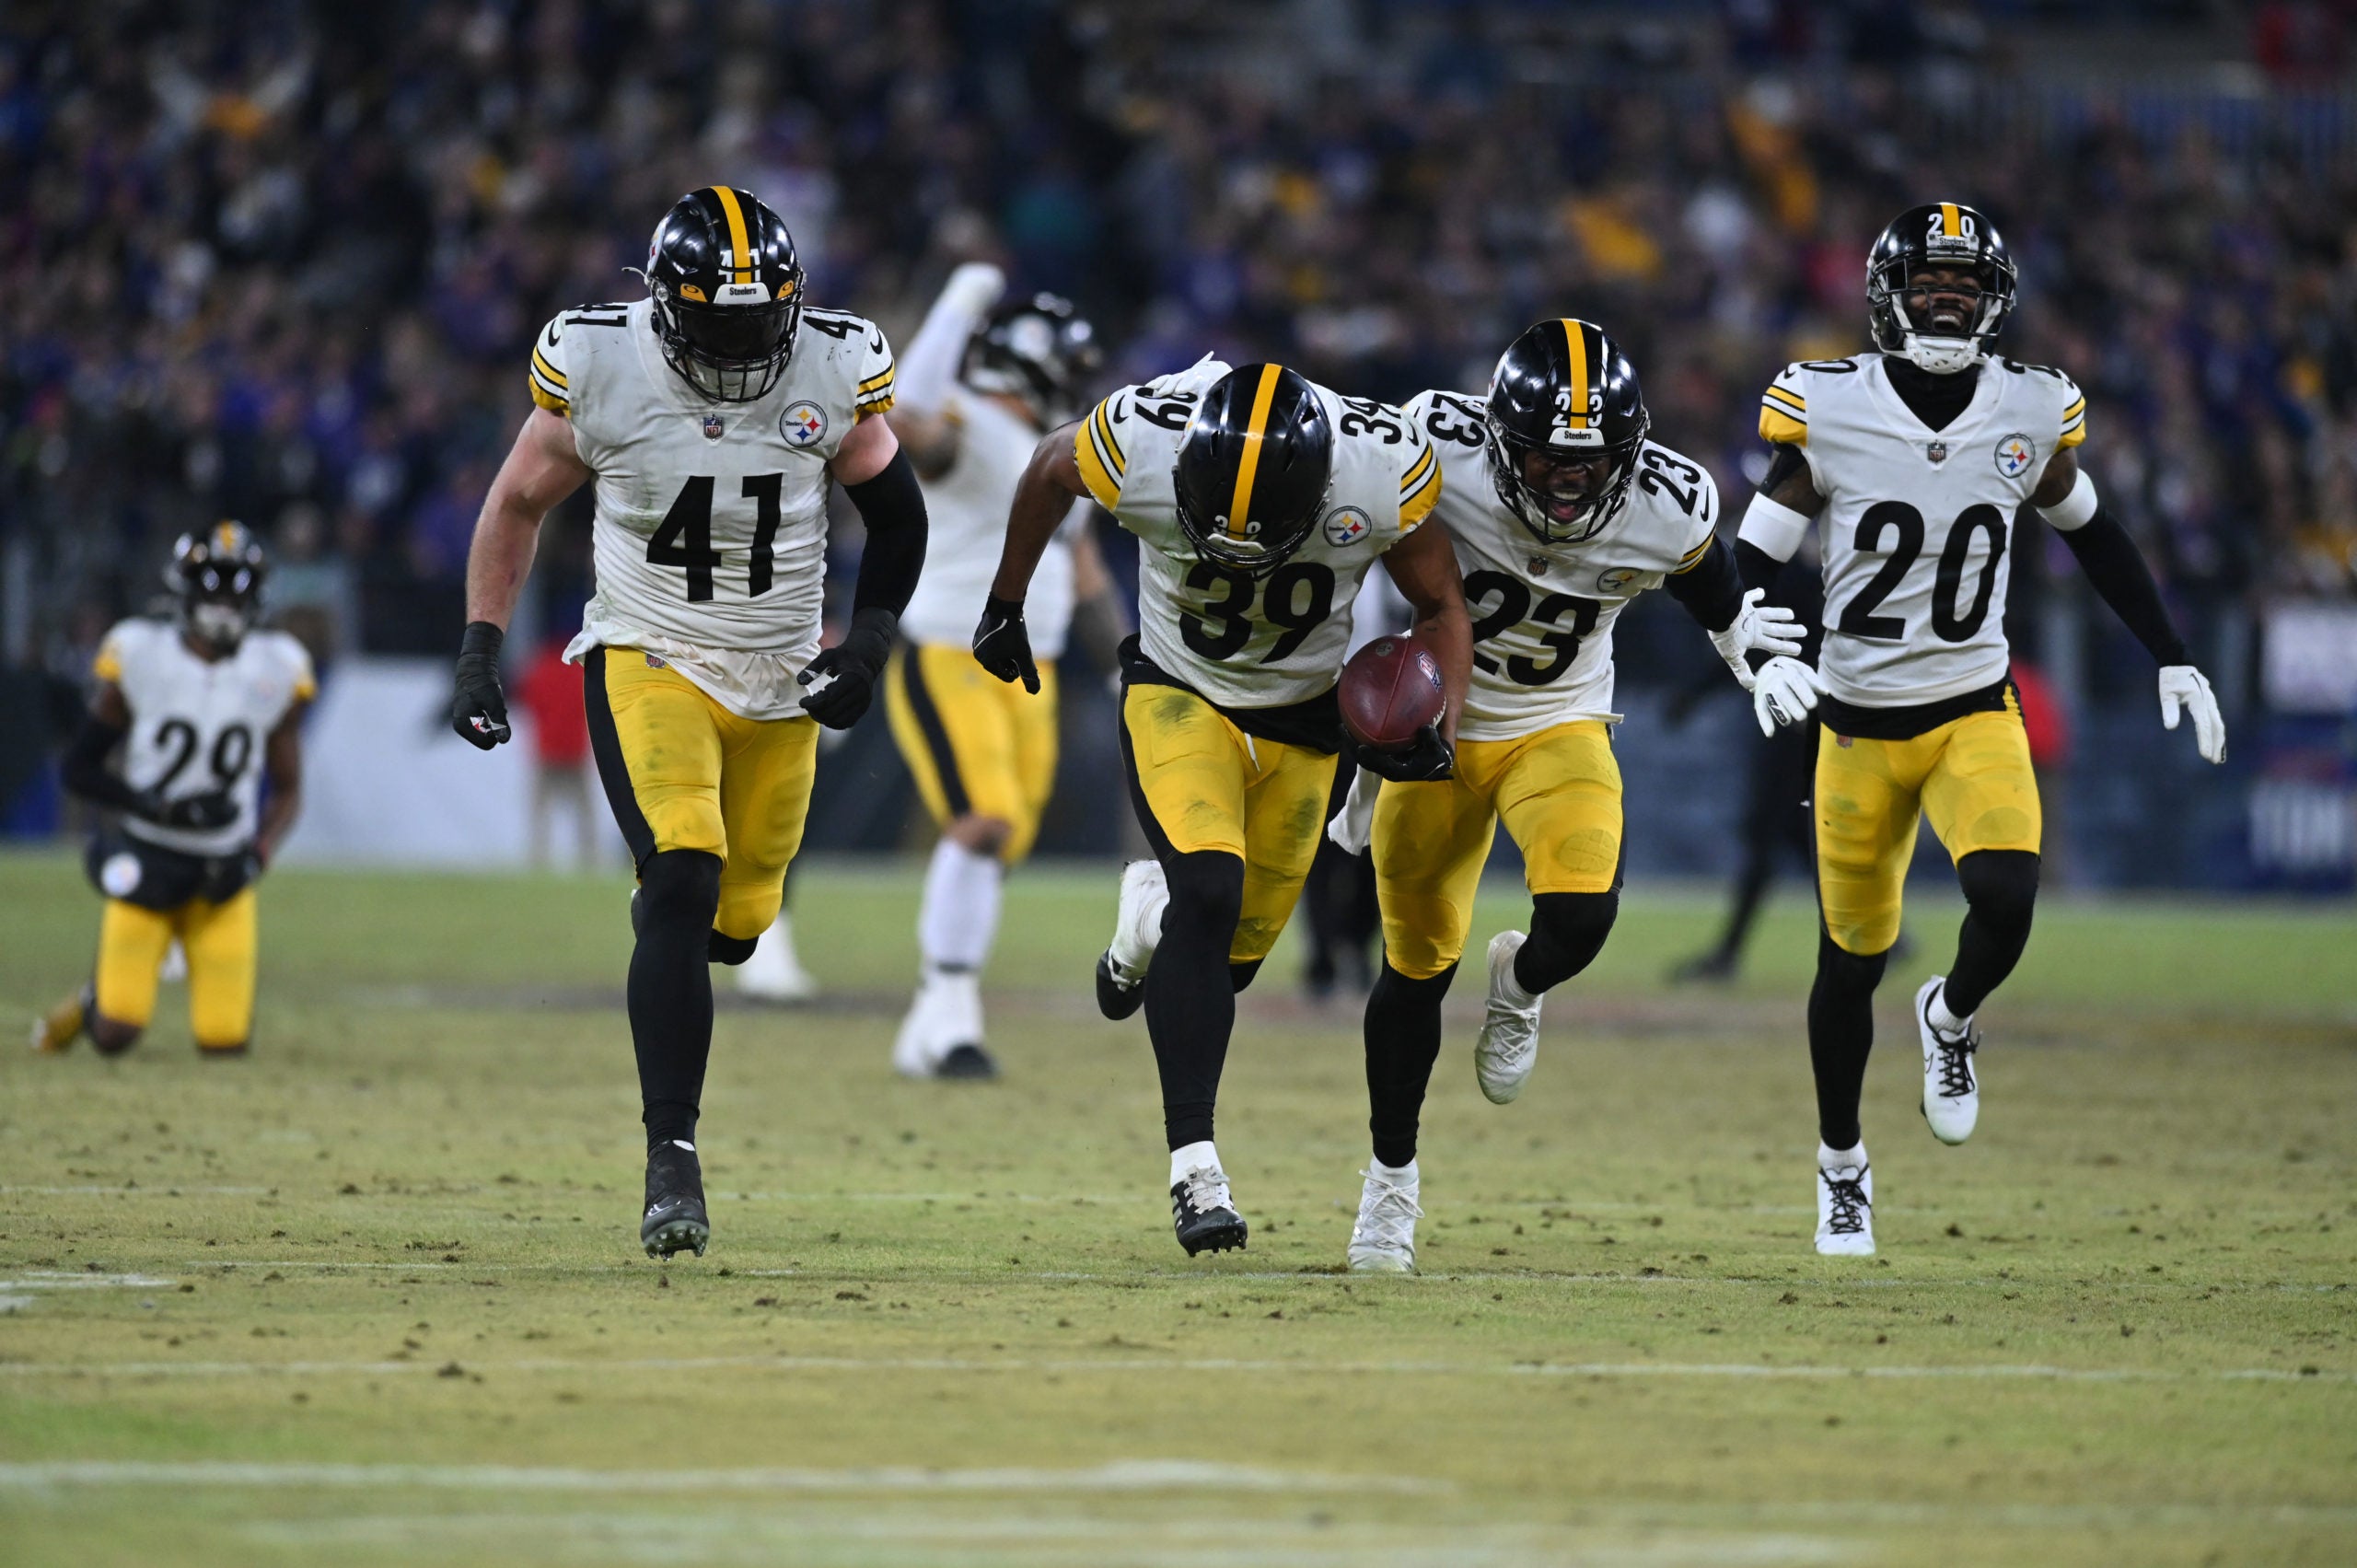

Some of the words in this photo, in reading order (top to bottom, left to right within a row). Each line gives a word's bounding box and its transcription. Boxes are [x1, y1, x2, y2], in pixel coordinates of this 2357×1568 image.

[1928, 213, 1975, 238] 20
[718, 248, 761, 284] 41
[729, 286, 757, 296] Steelers
[706, 425, 722, 436] NFL
[1340, 398, 1402, 445] 39
[1426, 393, 1486, 447] 23
[1552, 393, 1603, 427] 23
[1564, 430, 1592, 440] Steelers
[1640, 449, 1701, 517] 23
[646, 472, 784, 602] 41
[1838, 501, 2007, 643] 20
[1179, 562, 1335, 664] 39
[1464, 569, 1601, 686] 23
